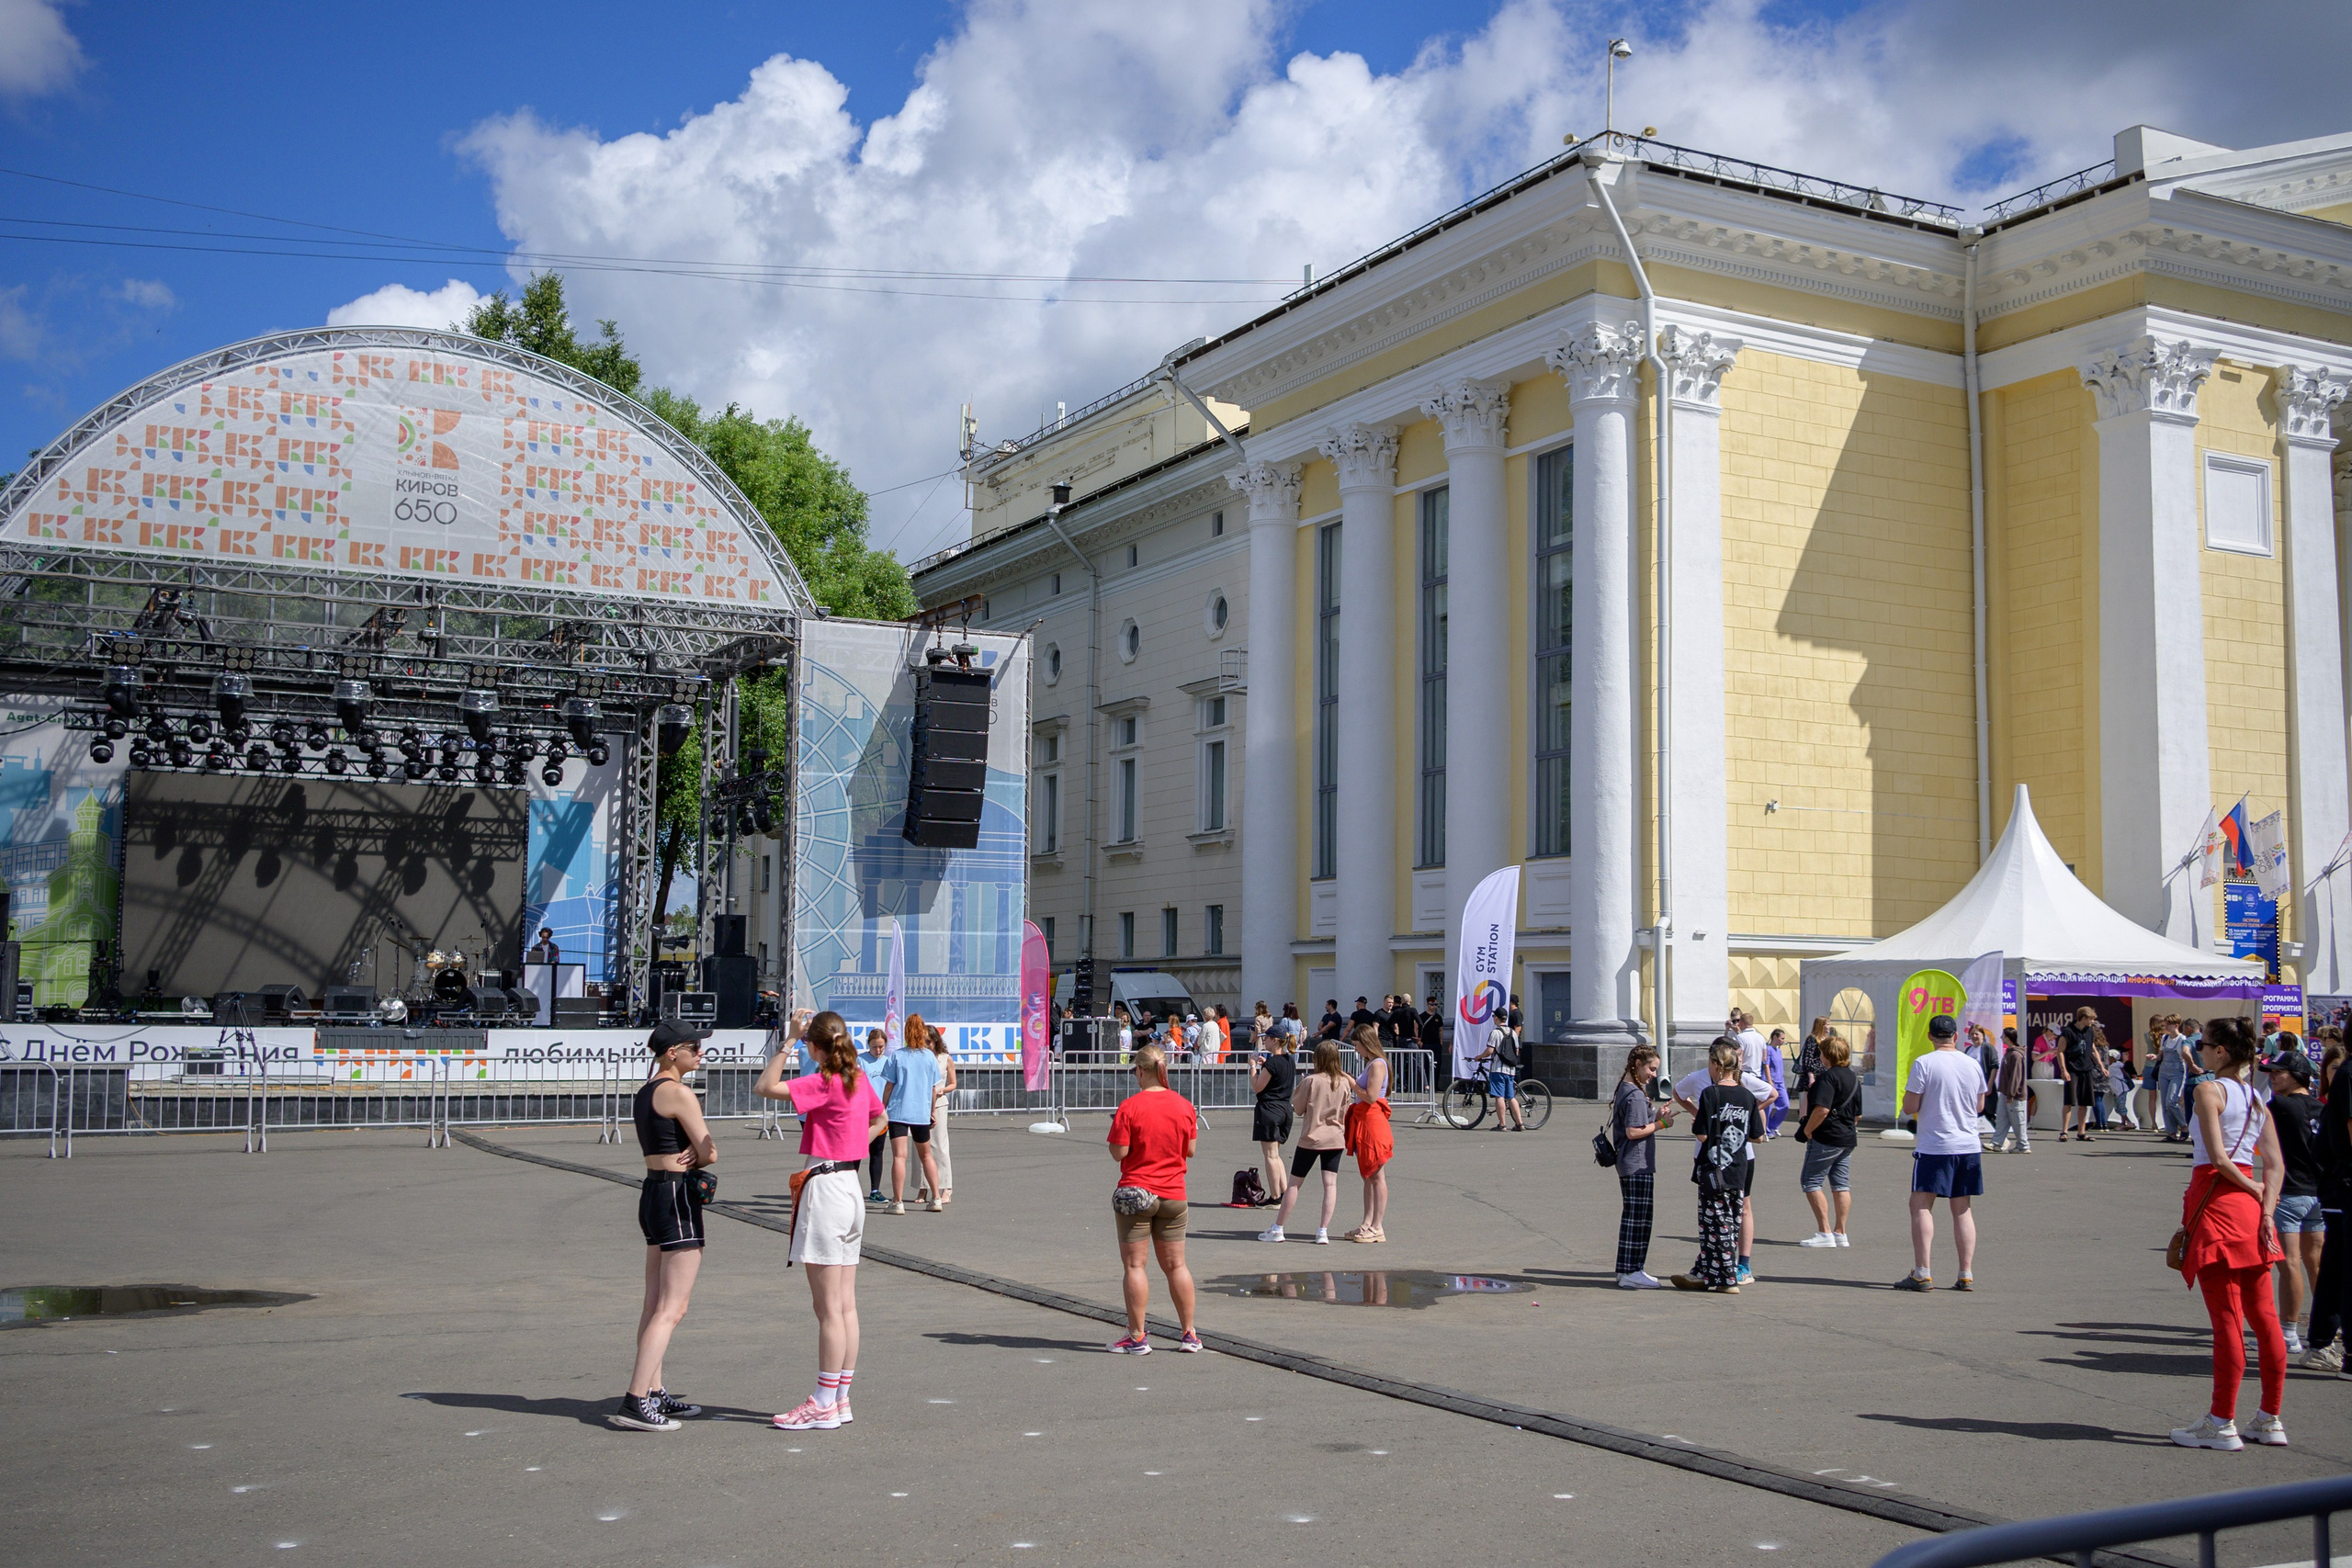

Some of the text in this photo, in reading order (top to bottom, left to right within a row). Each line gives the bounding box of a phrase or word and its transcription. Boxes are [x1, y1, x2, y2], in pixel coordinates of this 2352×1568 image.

[395, 479, 458, 497] КИРОВ
[395, 498, 458, 525] 650
[1476, 946, 1487, 973] GYM
[1487, 923, 1499, 974] STATION
[21, 1038, 116, 1063] Днём
[503, 1041, 647, 1065] любимый
